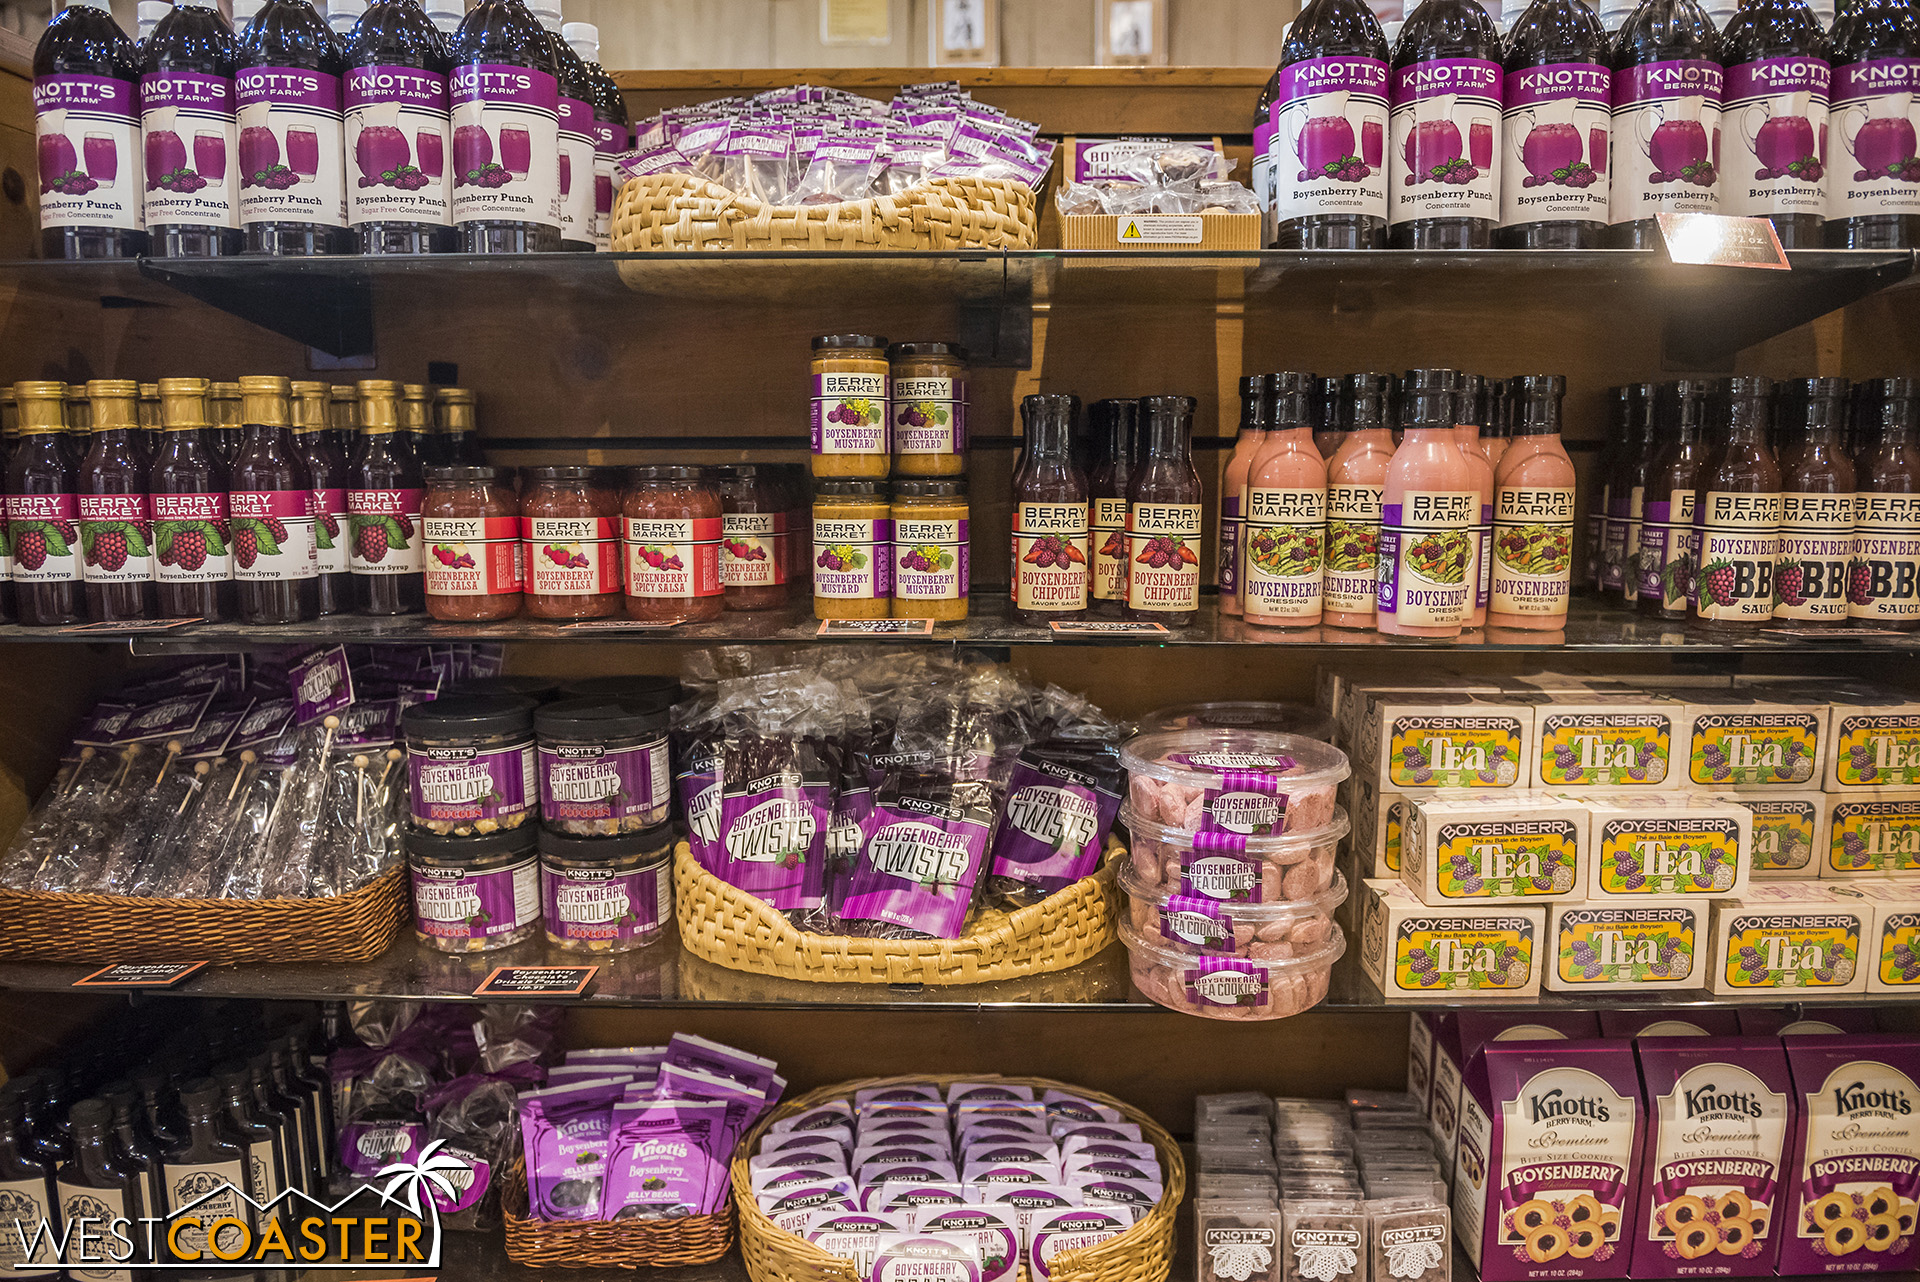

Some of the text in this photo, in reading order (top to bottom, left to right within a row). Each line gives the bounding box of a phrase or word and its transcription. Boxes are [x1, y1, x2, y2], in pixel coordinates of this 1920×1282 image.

[1295, 62, 1385, 83] KNOTT'S
[1403, 66, 1496, 88] KNOTT'S
[350, 74, 442, 95] KNOTT'S
[1308, 78, 1376, 87] BERRY FARM
[1415, 80, 1485, 92] BERRY FARM
[1520, 69, 1610, 90] KNOTT'S
[361, 88, 430, 99] BERRY FARM
[1293, 187, 1383, 200] Boysenberry Punch
[1400, 189, 1492, 204] Boysenberry Punch
[356, 195, 447, 208] Boysenberry Punch
[1318, 199, 1363, 207] Concentrate
[361, 205, 441, 216] Sugar Free Concentrate
[826, 429, 882, 438] BOYSENBERRY
[834, 439, 875, 448] MUSTARD
[81, 498, 141, 507] BERRY
[156, 496, 219, 507] BERRY
[1253, 493, 1324, 505] BERRY
[1502, 492, 1574, 504] BERRY
[81, 507, 142, 516] MARKET
[157, 507, 221, 515] MARKET
[1025, 508, 1086, 518] BERRY
[1252, 507, 1323, 516] MARKET
[1501, 505, 1573, 515] MARKET
[633, 523, 685, 531] BERRY
[1025, 519, 1086, 528] MARKET
[428, 571, 481, 580] BOYSENBERRY
[633, 573, 688, 582] BOYSENBERRY
[899, 574, 954, 584] BOYSENBERRY
[1023, 572, 1085, 585] BOYSENBERRY
[1135, 572, 1197, 585] BOYSENBERRY
[1798, 561, 1850, 599] BB
[430, 581, 478, 590] SPICY SALSA
[635, 583, 685, 592] SPICY SALSA
[906, 585, 946, 594] MUSTARD
[1249, 581, 1321, 597] BOYSENBERRY
[1495, 579, 1569, 595] BOYSENBERRY
[1032, 587, 1080, 599] CHIPOTLE
[1144, 587, 1192, 600] CHIPOTLE
[298, 661, 342, 705] ROCK CANDY
[1396, 717, 1520, 731] BOYSENBERRY
[1547, 714, 1668, 731] BOYSENBERRY
[1697, 714, 1816, 730] BOYSENBERRY
[558, 747, 602, 756] KNOTT'S
[421, 762, 489, 783] BOYSENBERRY
[551, 762, 617, 781] BOYSENBERRY
[1042, 763, 1095, 785] KNOTT'S
[750, 775, 800, 791] KNOTT'S
[422, 779, 491, 802] CHOCOLATE
[552, 779, 619, 801] CHOCOLATE
[902, 799, 961, 818] KNOTT'S
[1017, 787, 1101, 817] BOYSENBERRY
[1214, 798, 1280, 809] BOYSENBERRY
[431, 809, 482, 818] POPCORN
[560, 807, 610, 817] POPCORN
[733, 800, 814, 832] BOYSENBERRY
[1213, 808, 1278, 825] TEA COOKIES
[1008, 801, 1094, 847] TWISTS
[1441, 821, 1574, 840] BOYSENBERRY
[1606, 819, 1737, 836] BOYSENBERRY
[729, 819, 812, 863] TWISTS
[877, 827, 971, 850] BOYSENBERRY
[870, 844, 965, 881] TWISTS
[1564, 908, 1693, 926] BOYSENBERRY
[1734, 916, 1858, 931] BOYSENBERRY
[1402, 918, 1531, 934] BOYSENBERRY
[1685, 1084, 1762, 1119] Knott's
[1835, 1082, 1911, 1117] Knott's
[1531, 1089, 1610, 1125] Knott's
[1546, 1117, 1592, 1129] BERRY FARM
[1700, 1113, 1744, 1123] BERRY FARM
[1528, 1131, 1609, 1148] Premium
[1682, 1126, 1761, 1143] Premium
[361, 1136, 407, 1154] GUMMI
[632, 1139, 687, 1160] Knott's
[629, 1164, 684, 1177] Boysenberry
[1666, 1161, 1771, 1180] BOYSENBERRY
[1815, 1158, 1918, 1177] BOYSENBERRY
[1513, 1165, 1620, 1186] BOYSENBERRY
[626, 1191, 650, 1199] JELLY
[1094, 1188, 1133, 1199] KNOTT'S
[787, 1194, 827, 1208] KNOTT'S
[836, 1223, 877, 1231] KNOTT'S
[1061, 1221, 1103, 1229] KNOTT'S
[1211, 1231, 1271, 1240] KNOTT'S
[1296, 1232, 1357, 1242] KNOTT'S
[1385, 1228, 1441, 1241] KNOTT'S
[895, 1262, 957, 1276] BOYSENBERRY
